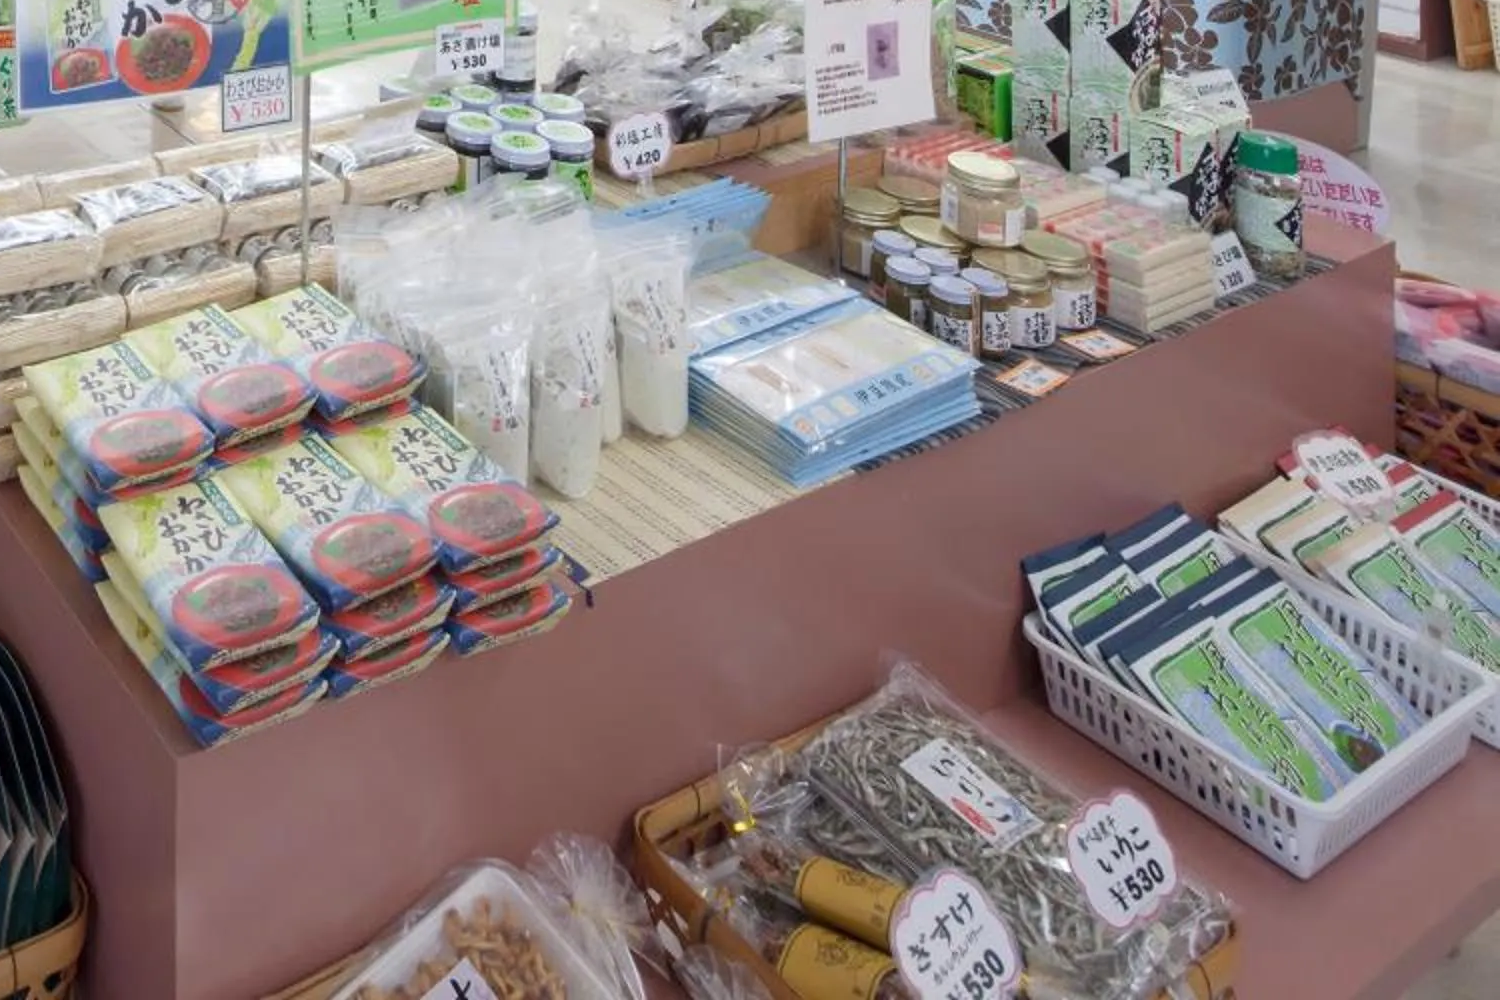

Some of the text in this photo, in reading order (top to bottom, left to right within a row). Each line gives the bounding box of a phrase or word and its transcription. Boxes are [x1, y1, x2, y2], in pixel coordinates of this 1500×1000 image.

[174, 331, 225, 376] おかか
[187, 318, 234, 357] わさび
[79, 373, 128, 418] おかか
[97, 356, 138, 403] わさび
[391, 443, 453, 494] おかか
[402, 426, 462, 475] わさび
[276, 475, 338, 526] おかか
[287, 455, 347, 502] わさび
[158, 512, 214, 576] おかか
[178, 495, 229, 547] わさび
[1097, 824, 1152, 874] いりこ
[1108, 858, 1166, 912] ¥530
[907, 891, 975, 974] ぎすけ
